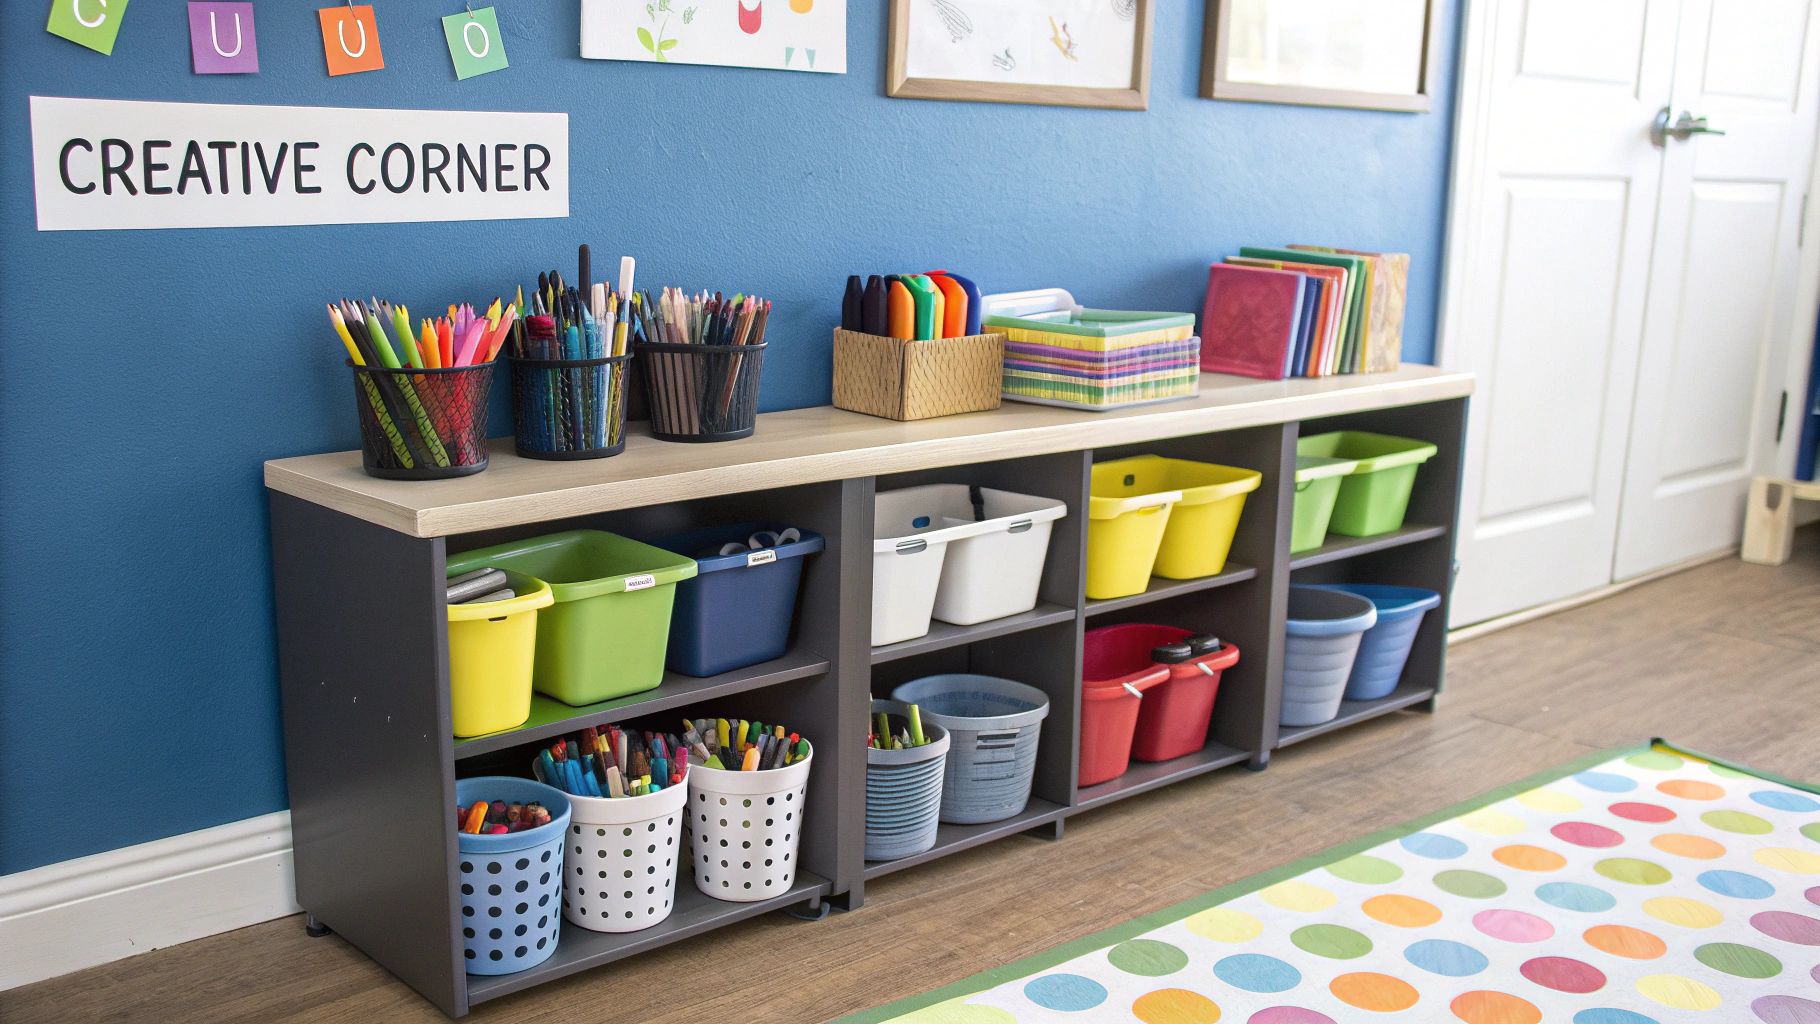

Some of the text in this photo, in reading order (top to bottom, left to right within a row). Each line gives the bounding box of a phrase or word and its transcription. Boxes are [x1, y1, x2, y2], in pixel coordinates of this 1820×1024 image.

[210, 11, 242, 58] U
[338, 19, 366, 58] U
[463, 21, 490, 59] O
[59, 137, 551, 196] CREATIVE CORNER
